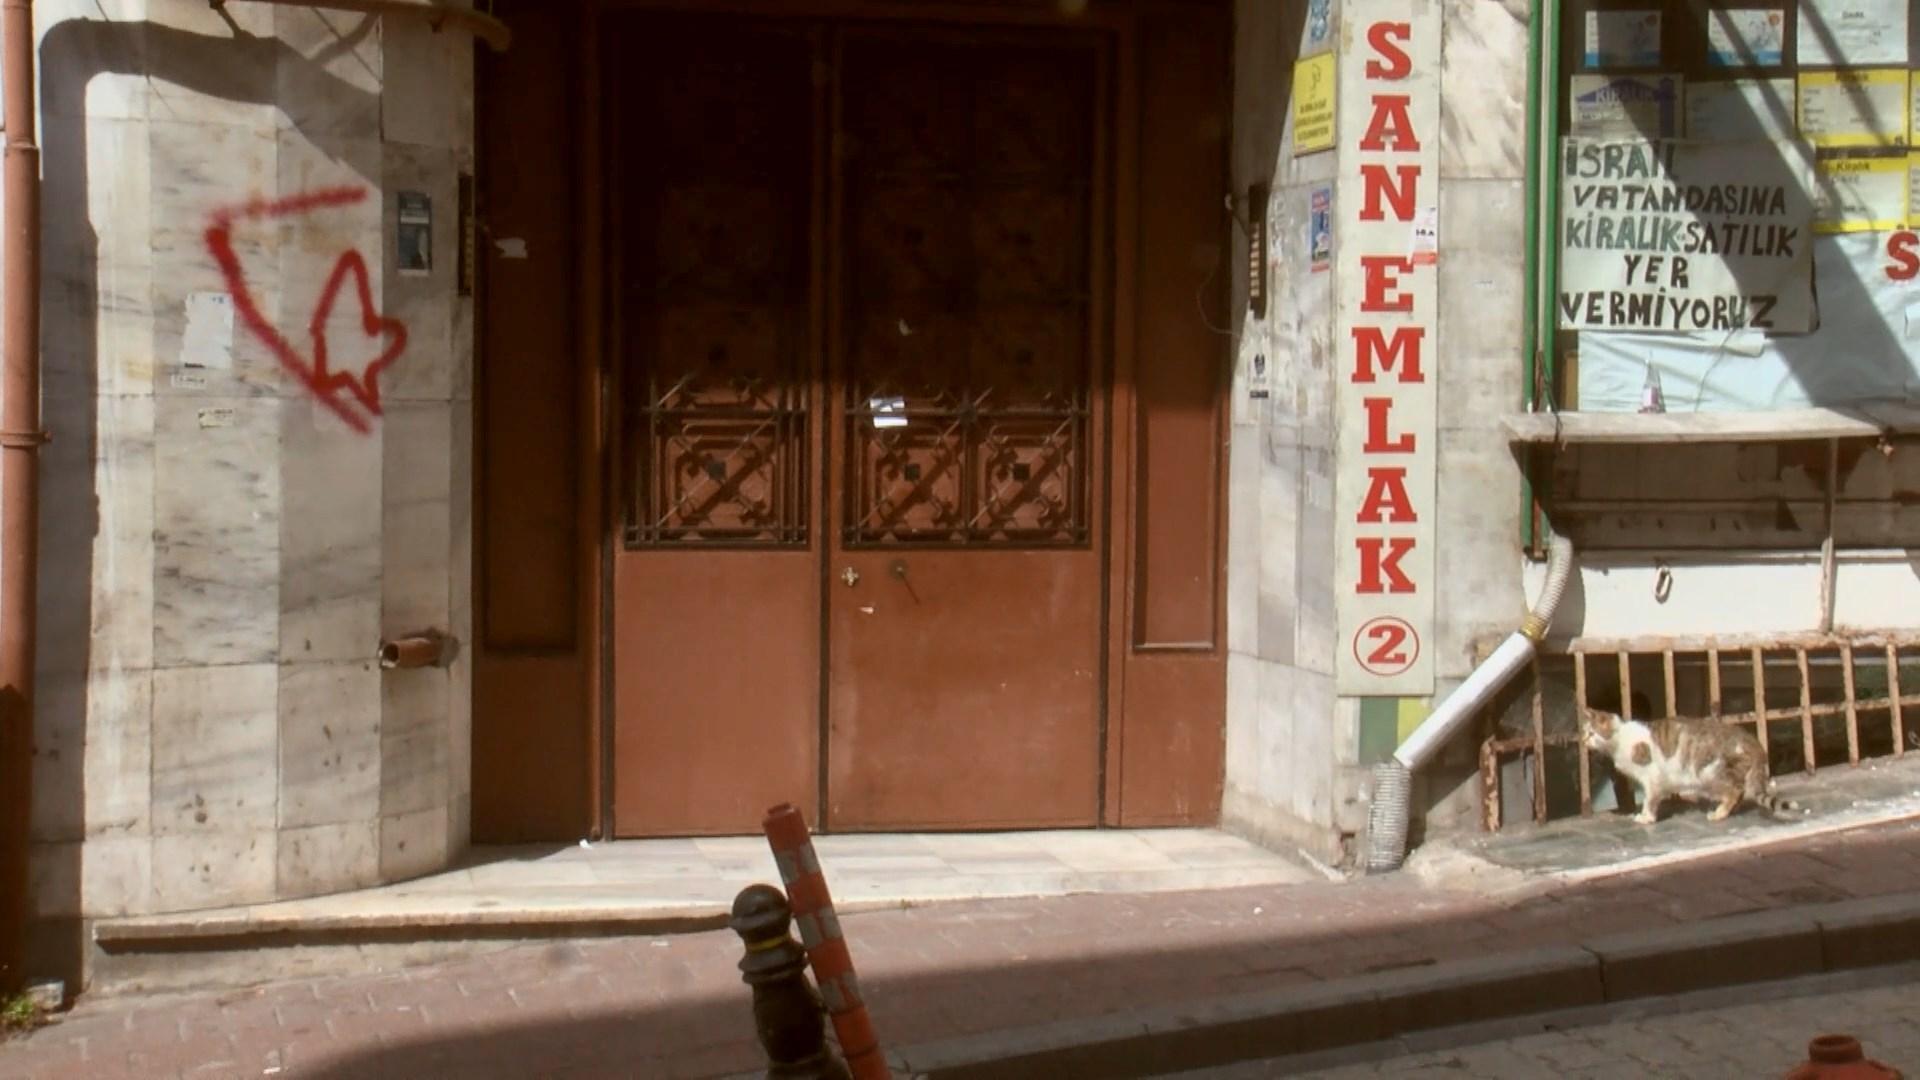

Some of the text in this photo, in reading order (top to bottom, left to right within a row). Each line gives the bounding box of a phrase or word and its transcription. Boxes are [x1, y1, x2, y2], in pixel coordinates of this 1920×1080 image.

[1566, 211, 1682, 252] KİRALIK
[1684, 221, 1798, 257] SATILIK
[1624, 254, 1689, 288] YER
[1561, 287, 1777, 330] VERMİYORUZ
[1352, 22, 1425, 663] SAN EMLAK 2
